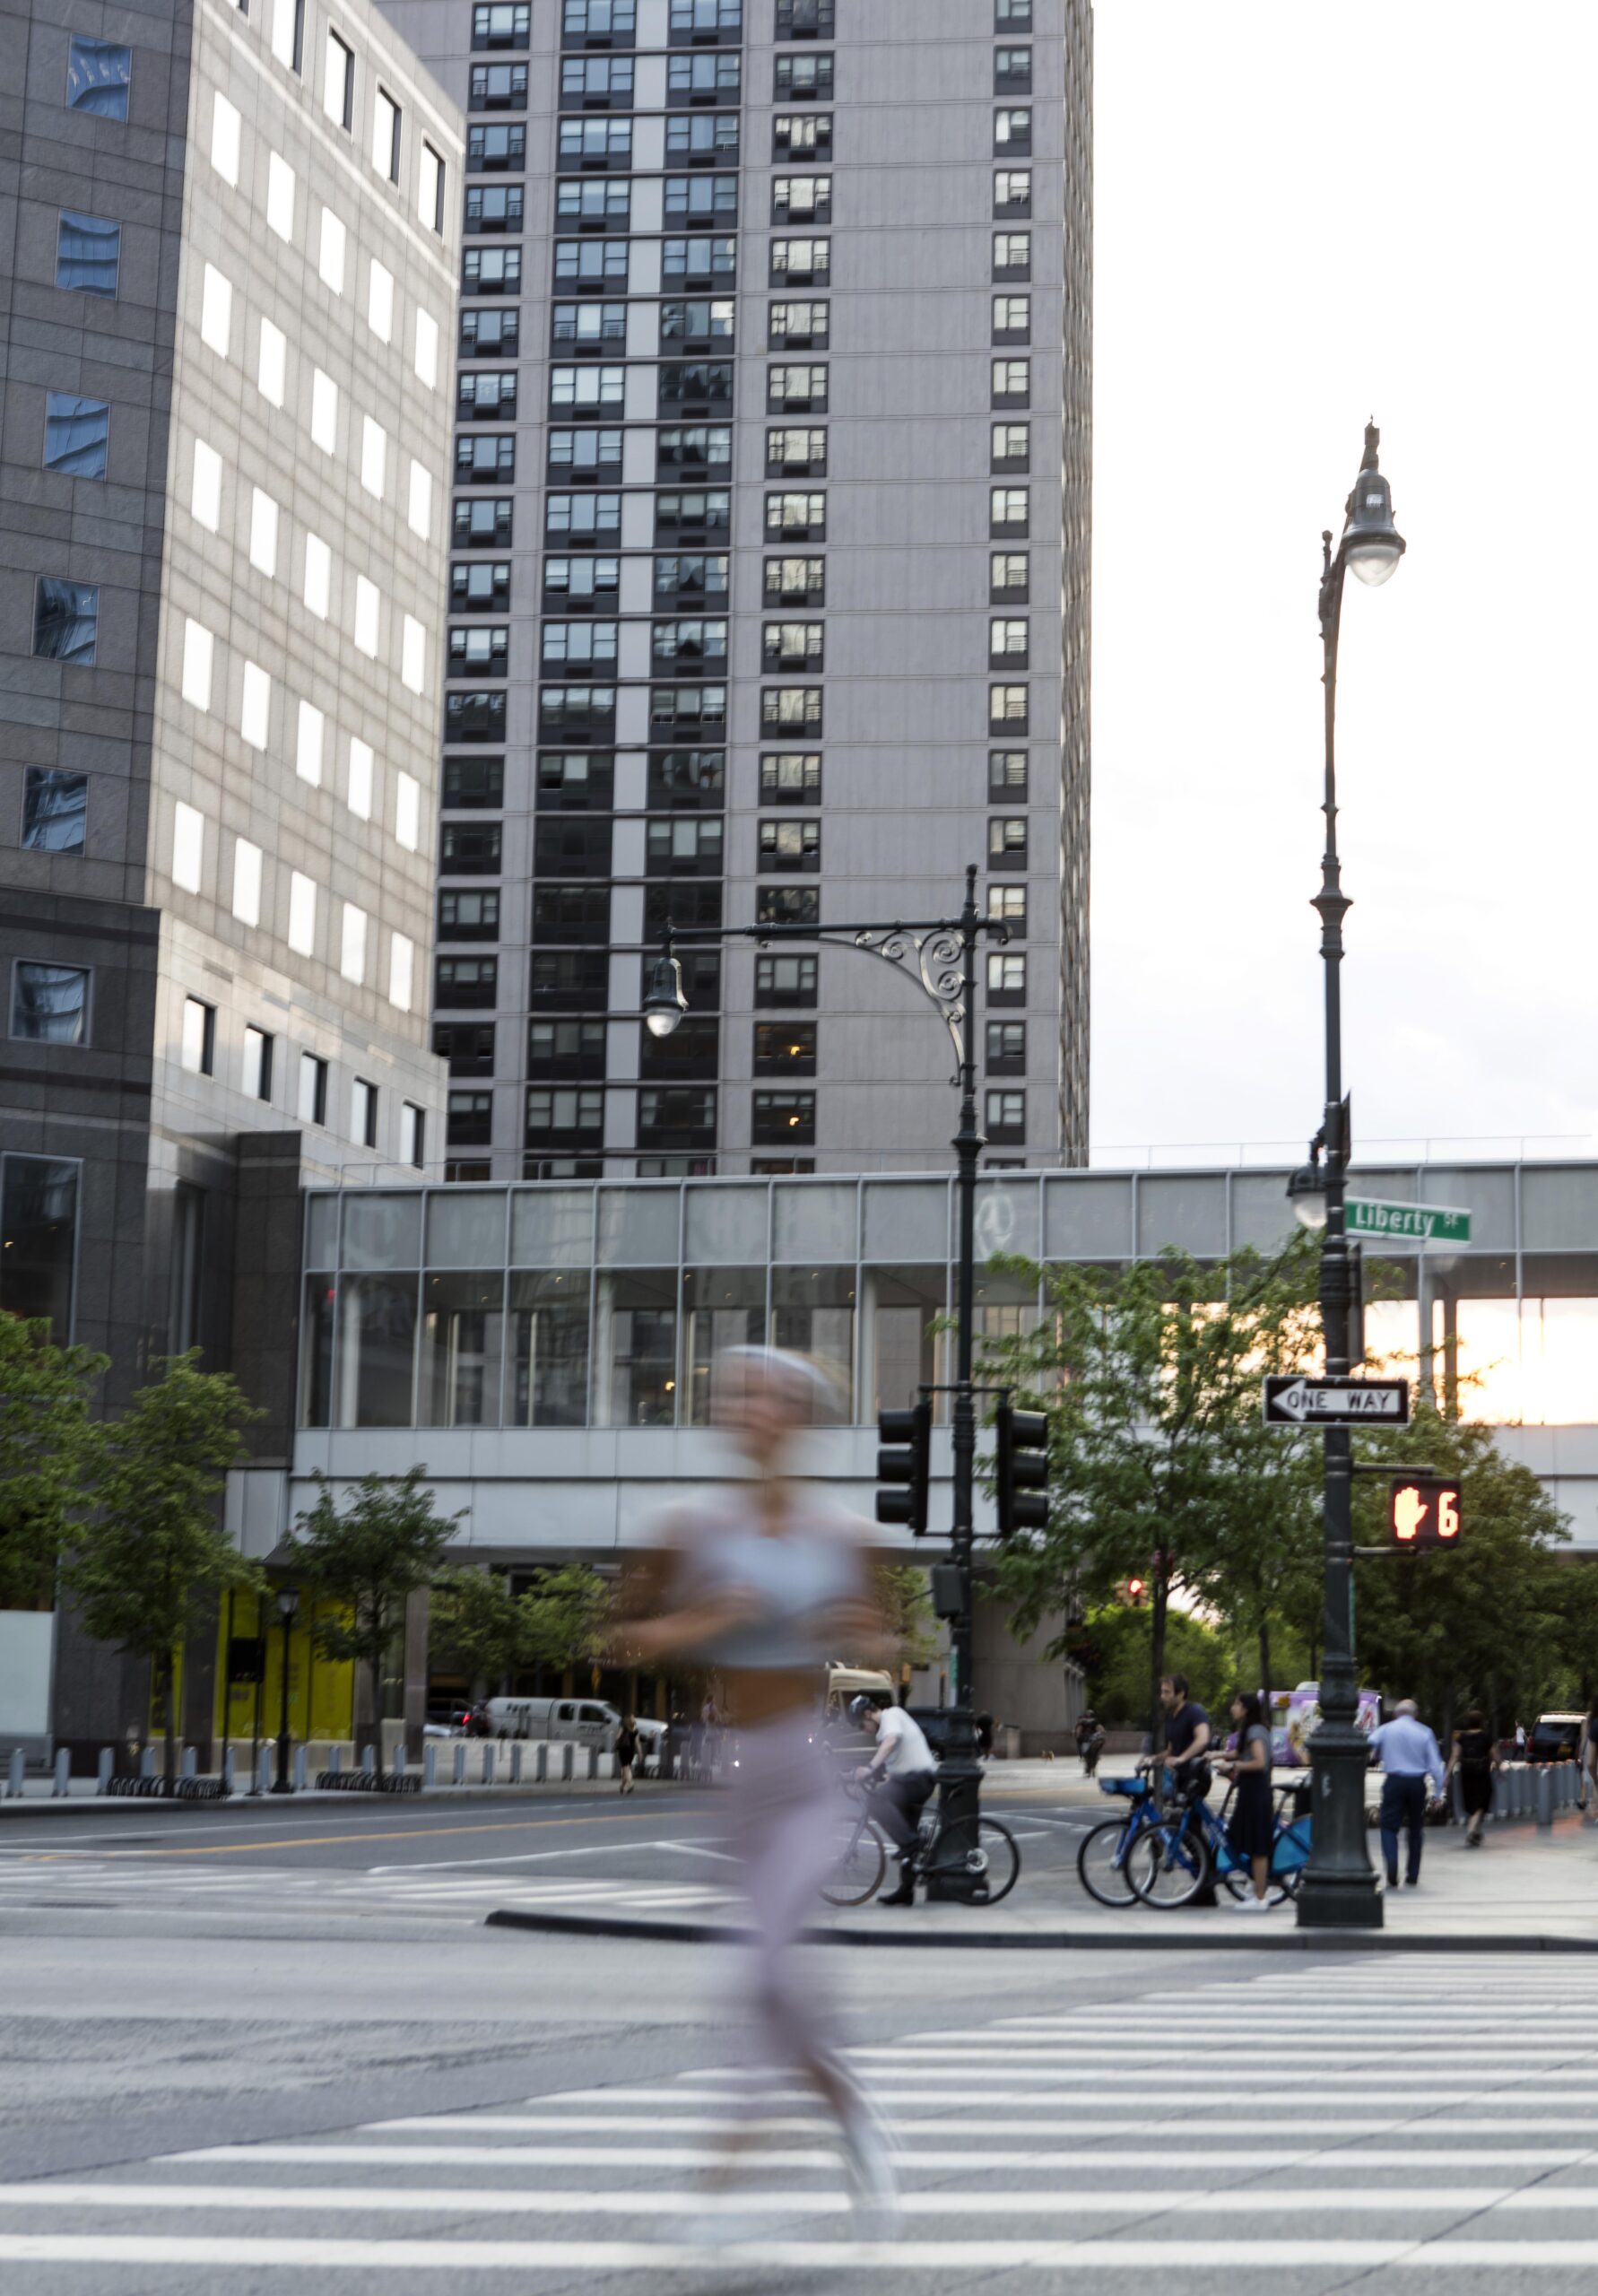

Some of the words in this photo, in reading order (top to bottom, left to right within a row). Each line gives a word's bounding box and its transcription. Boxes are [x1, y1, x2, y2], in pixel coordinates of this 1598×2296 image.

[1355, 1204, 1436, 1237] Liberty
[1287, 1390, 1328, 1409] ONE
[1347, 1391, 1392, 1410] WAY
[1438, 1492, 1459, 1537] 6
